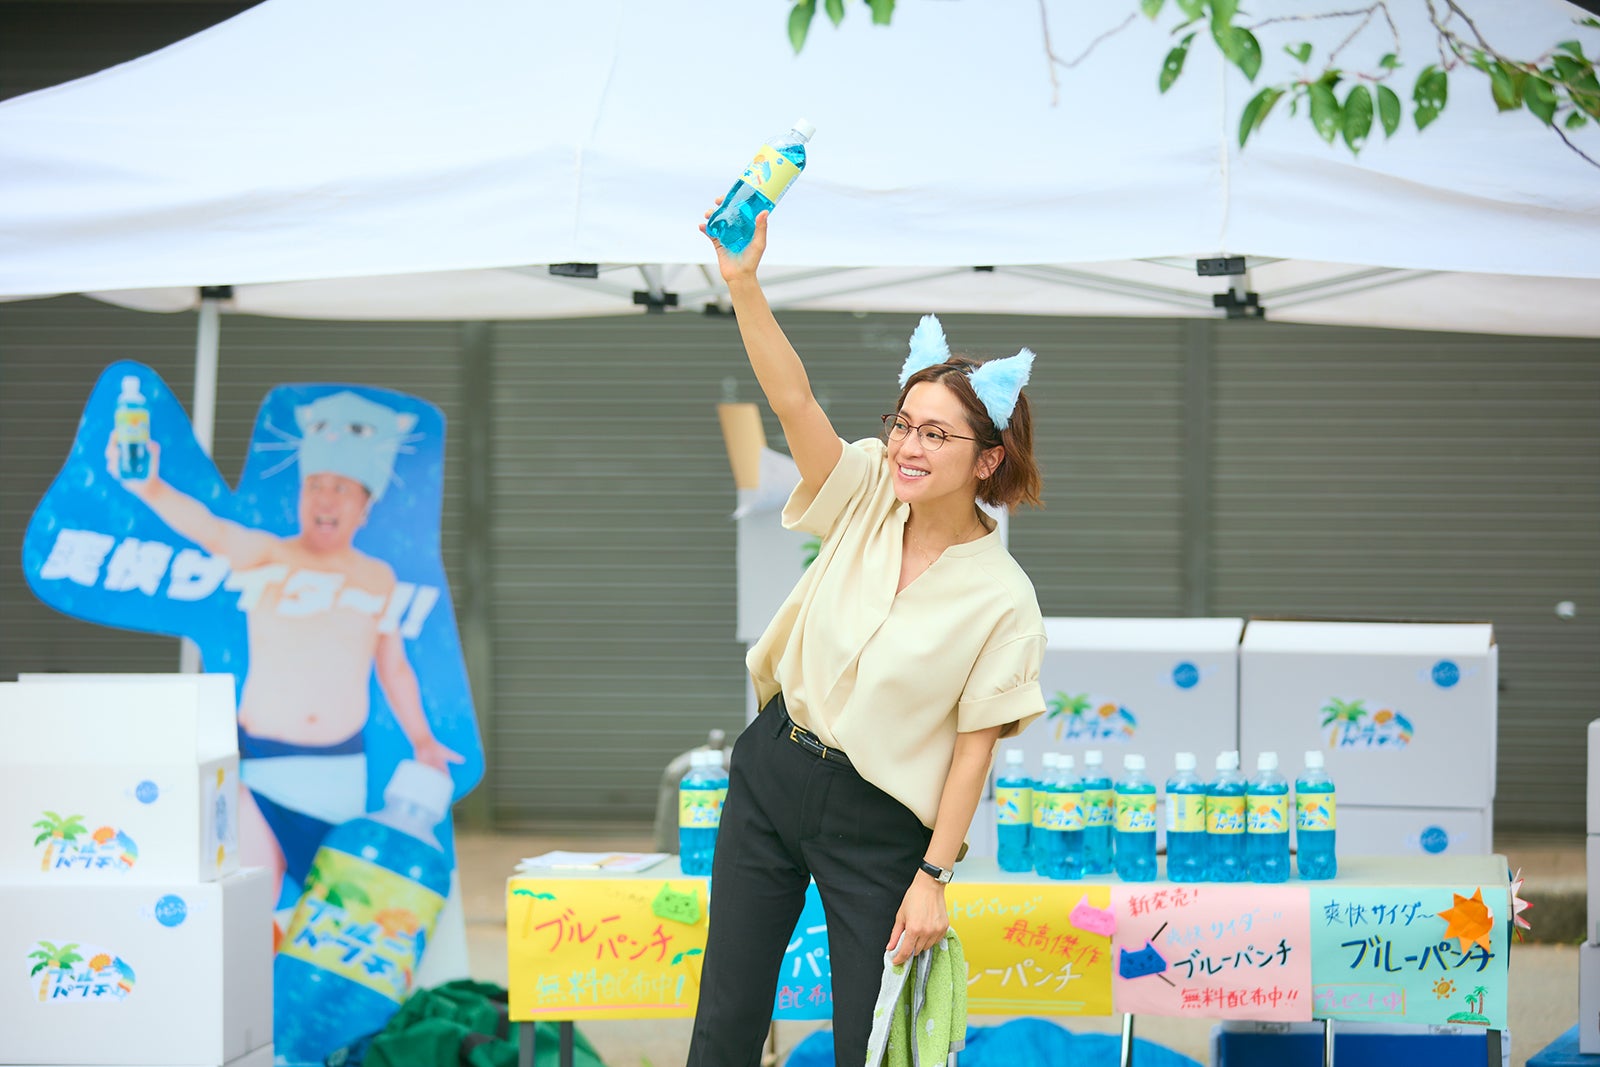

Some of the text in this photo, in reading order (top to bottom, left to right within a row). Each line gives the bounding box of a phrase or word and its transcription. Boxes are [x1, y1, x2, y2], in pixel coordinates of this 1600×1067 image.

[1003, 919, 1103, 967] 最高傑作
[1173, 939, 1292, 979] ブルーパンチ
[778, 984, 833, 1011] 配布
